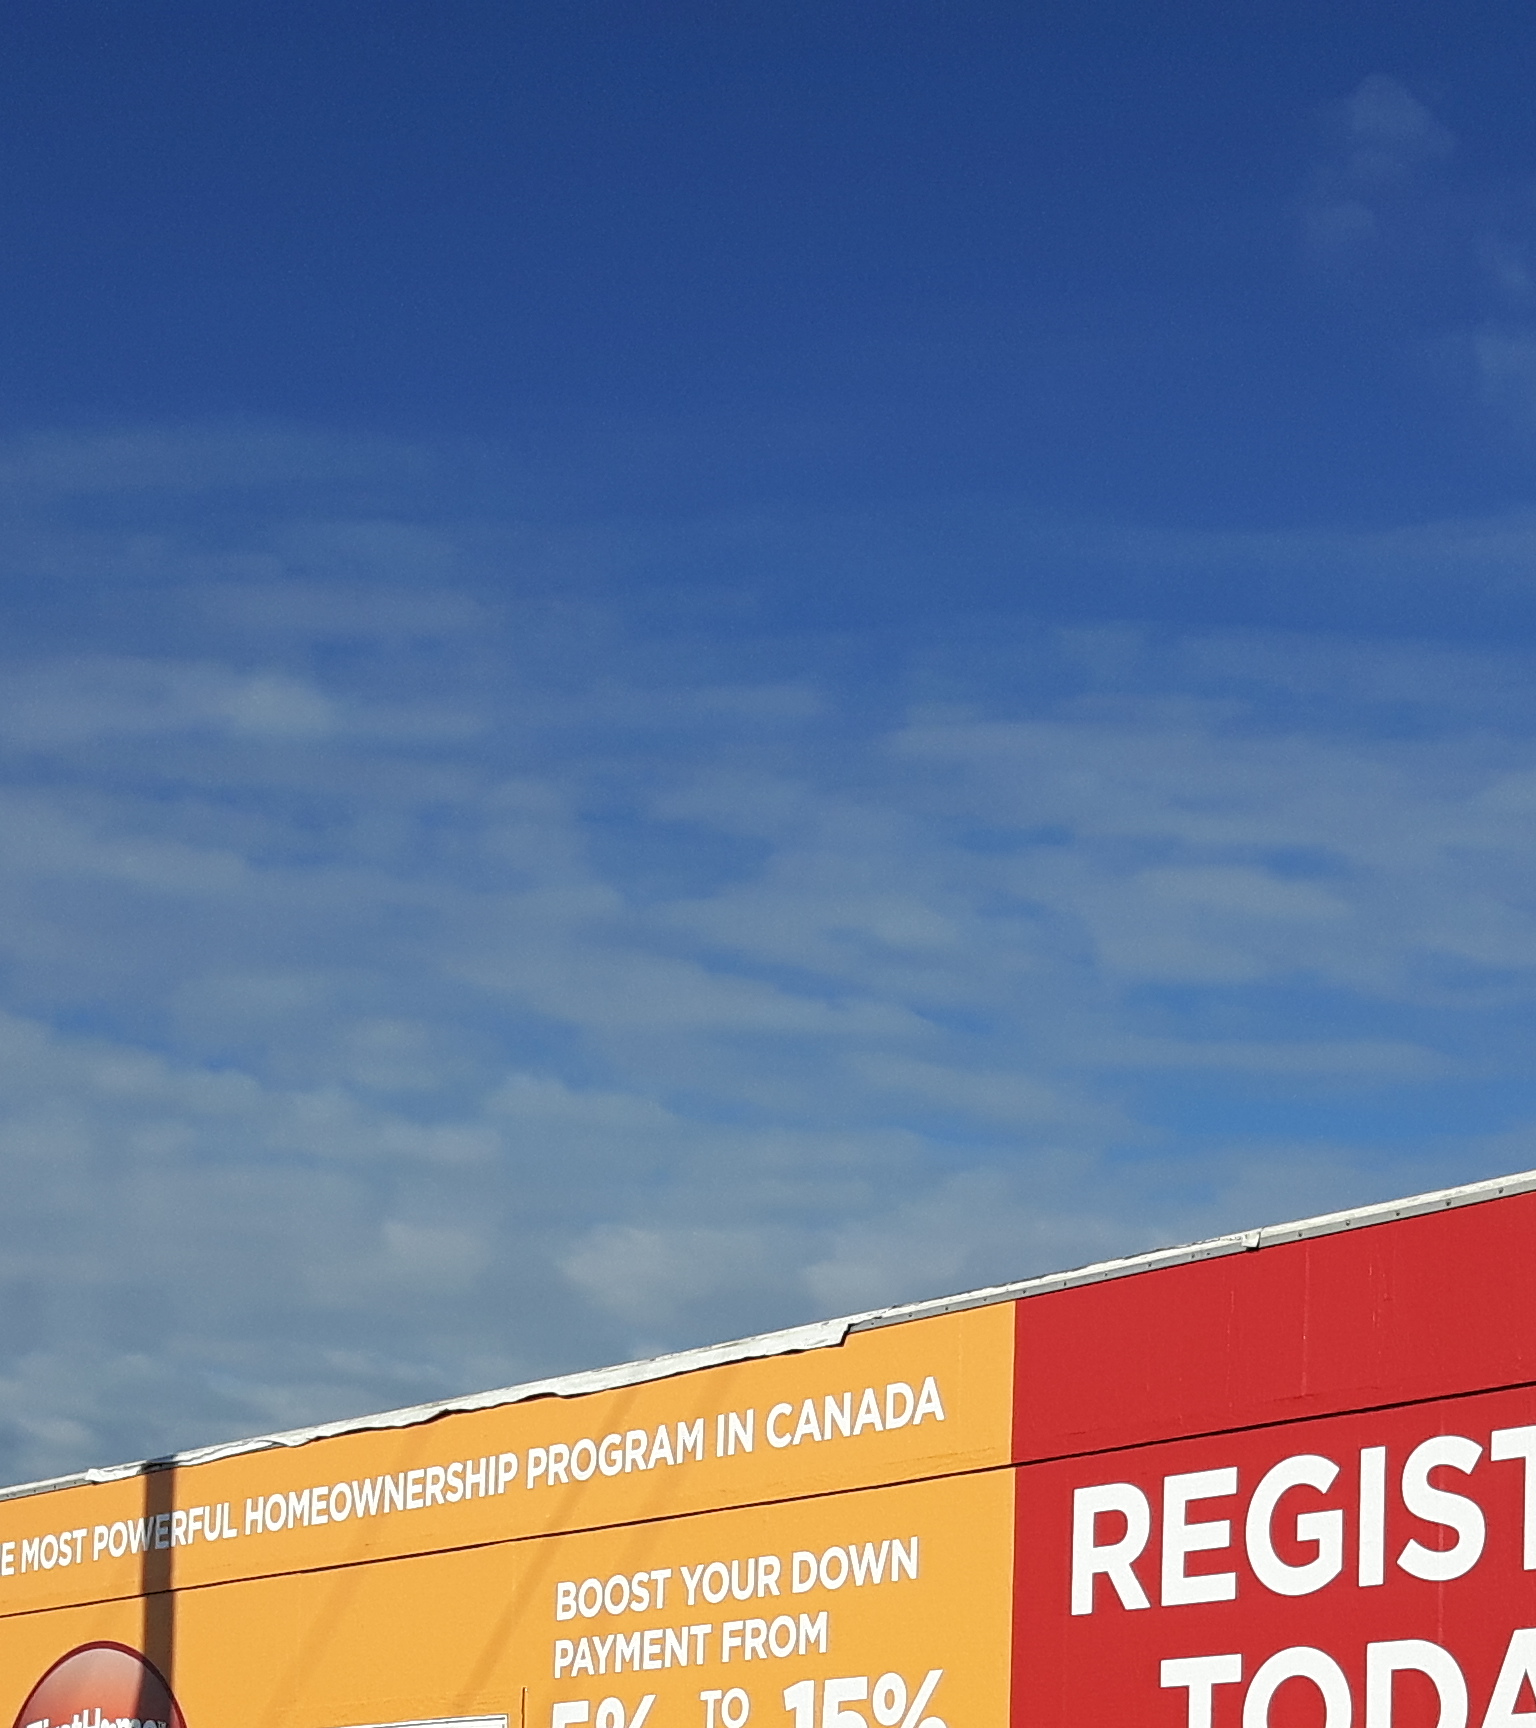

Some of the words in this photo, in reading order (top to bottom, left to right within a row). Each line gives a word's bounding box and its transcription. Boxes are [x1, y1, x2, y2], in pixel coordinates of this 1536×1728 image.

[20, 1527, 86, 1573] MOST
[92, 1509, 238, 1562] POWERFUL
[244, 1452, 518, 1538] HOMEOWNERSHIP
[526, 1415, 705, 1491] PROGRAM
[715, 1408, 755, 1457] IN
[764, 1374, 946, 1449] CANADA
[557, 1569, 671, 1621] BOOST
[680, 1556, 780, 1605] YOUR
[792, 1536, 918, 1593] DOWN
[555, 1624, 712, 1678] PAYMENT
[722, 1612, 827, 1662] FROM
